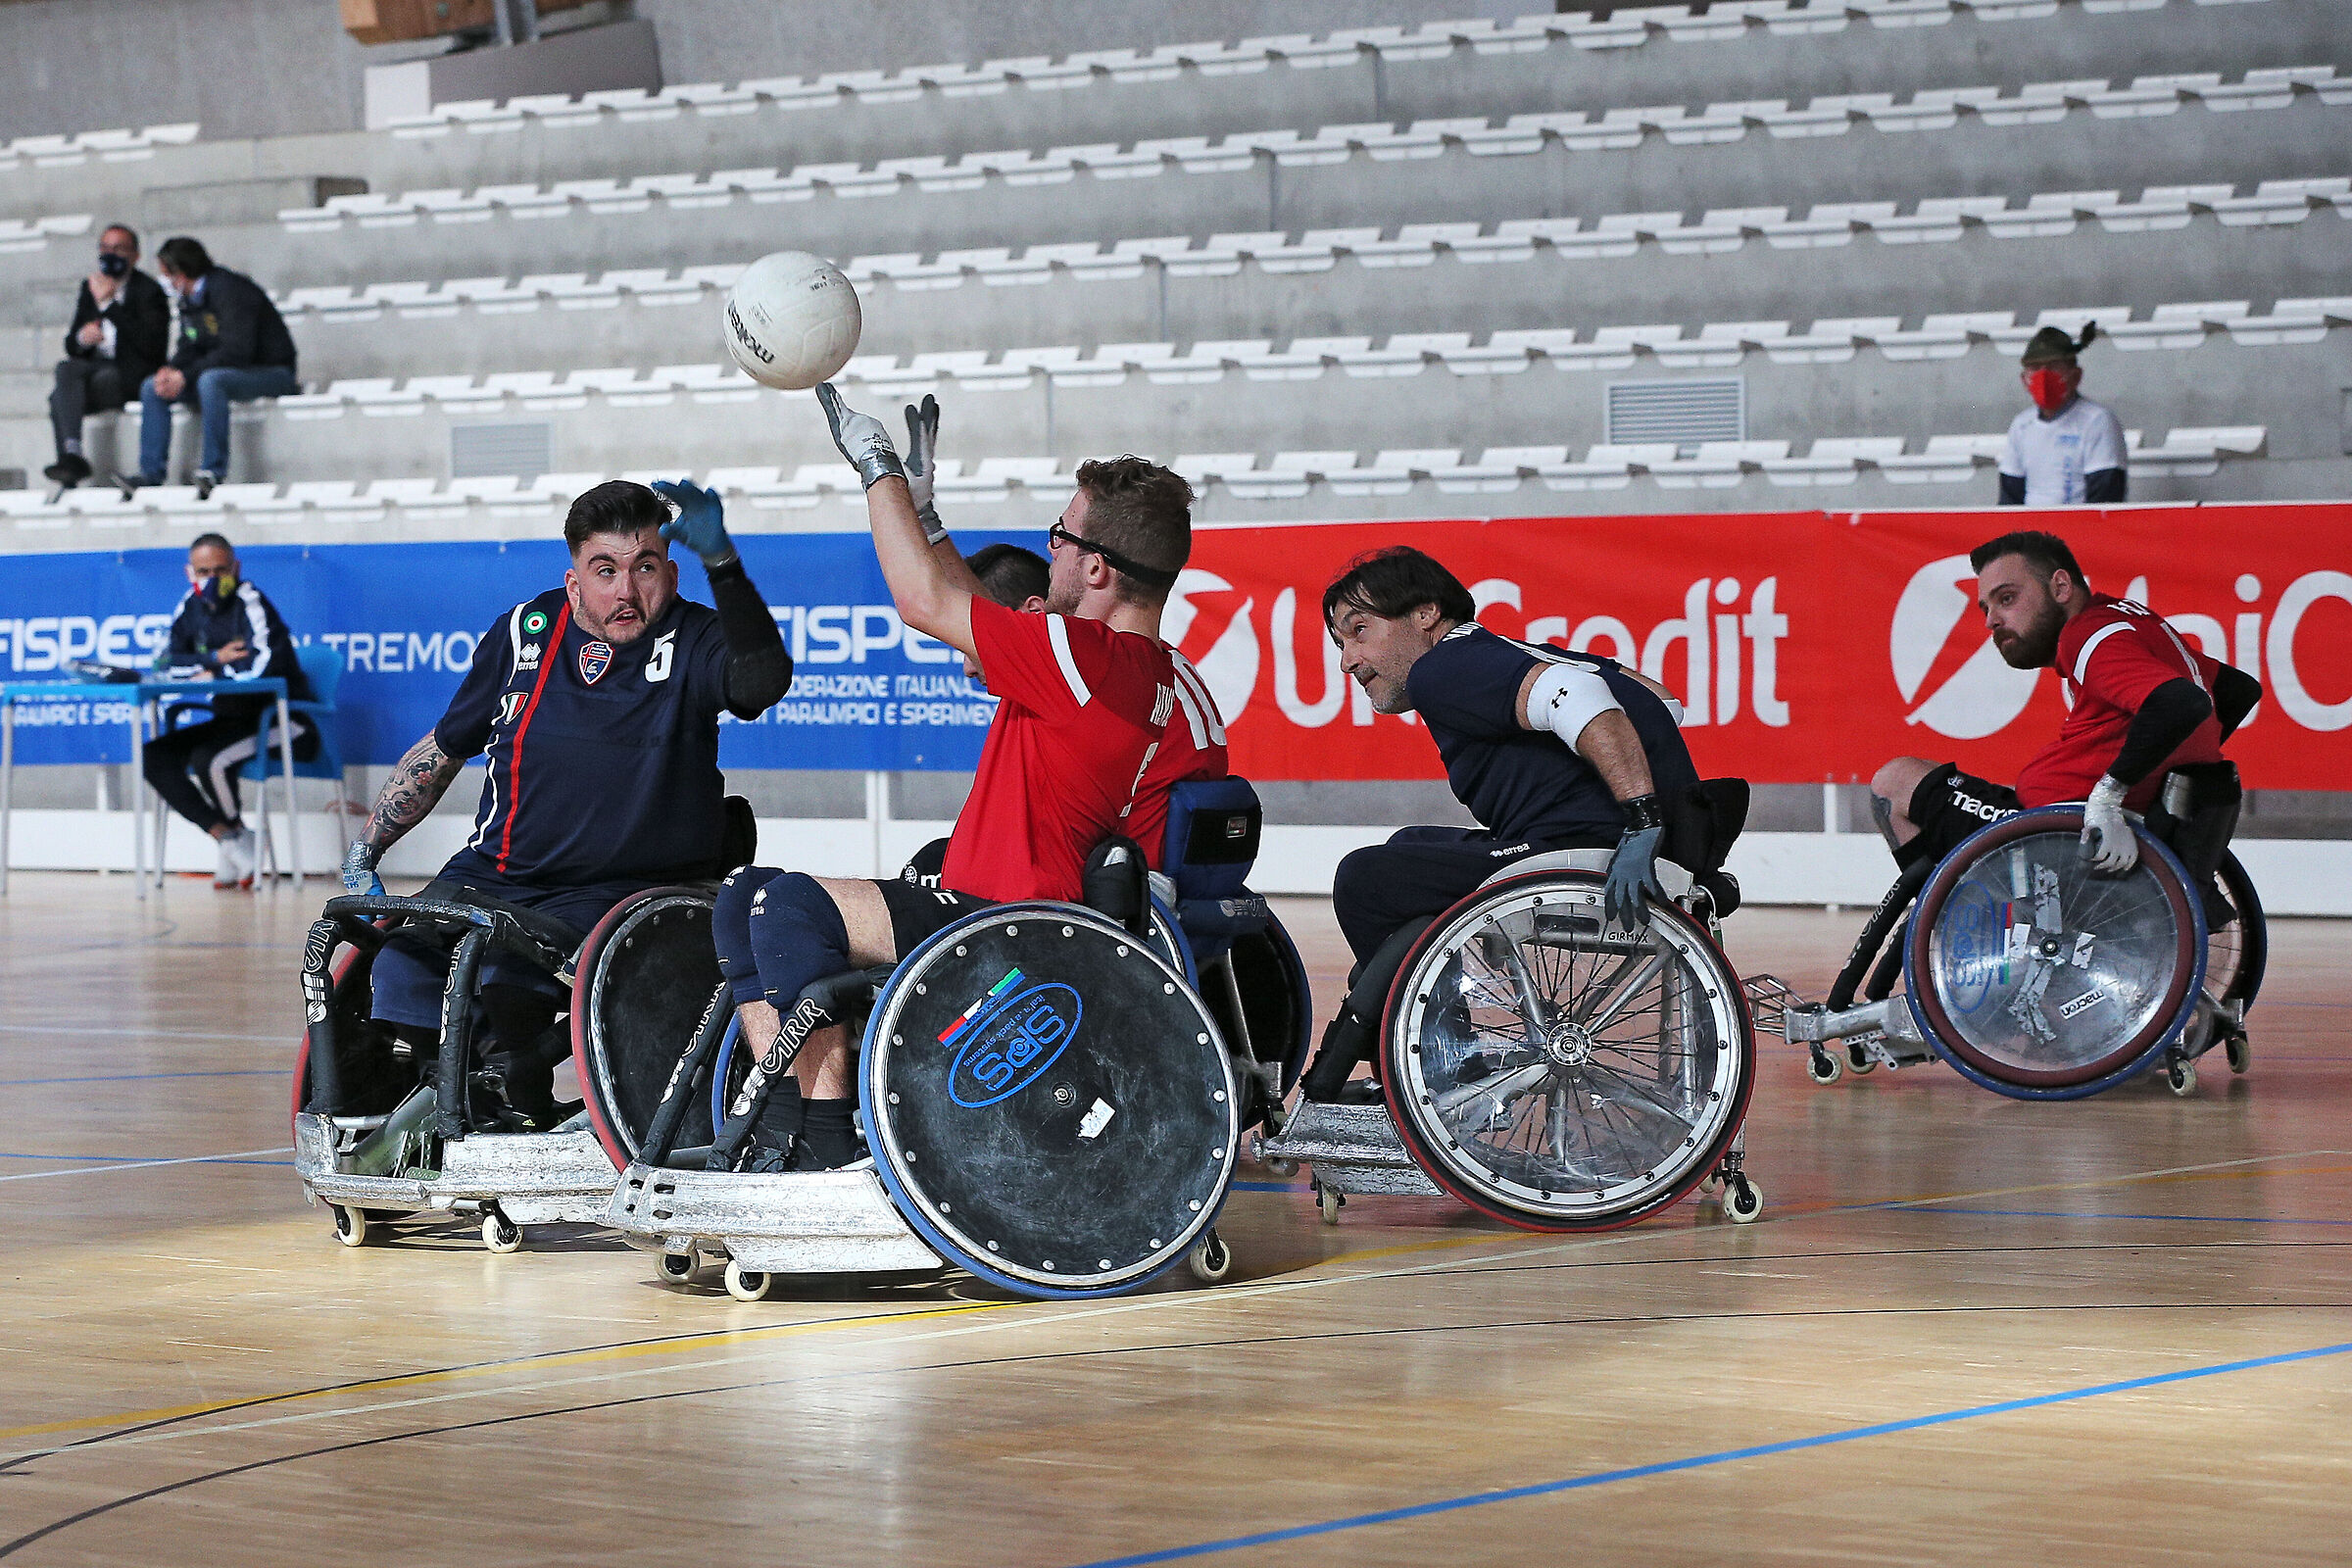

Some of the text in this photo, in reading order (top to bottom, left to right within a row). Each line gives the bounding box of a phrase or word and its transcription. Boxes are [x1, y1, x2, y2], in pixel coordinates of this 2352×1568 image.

[767, 605, 967, 664] ISPE
[644, 627, 677, 683] 5
[790, 674, 889, 699] DERAZIONE
[884, 702, 898, 726] E
[1607, 930, 1649, 945] GIRMAX
[2061, 989, 2105, 1016] macron
[998, 1016, 1017, 1040] pack
[962, 1034, 998, 1067] systems
[972, 1004, 1066, 1092] SPS
